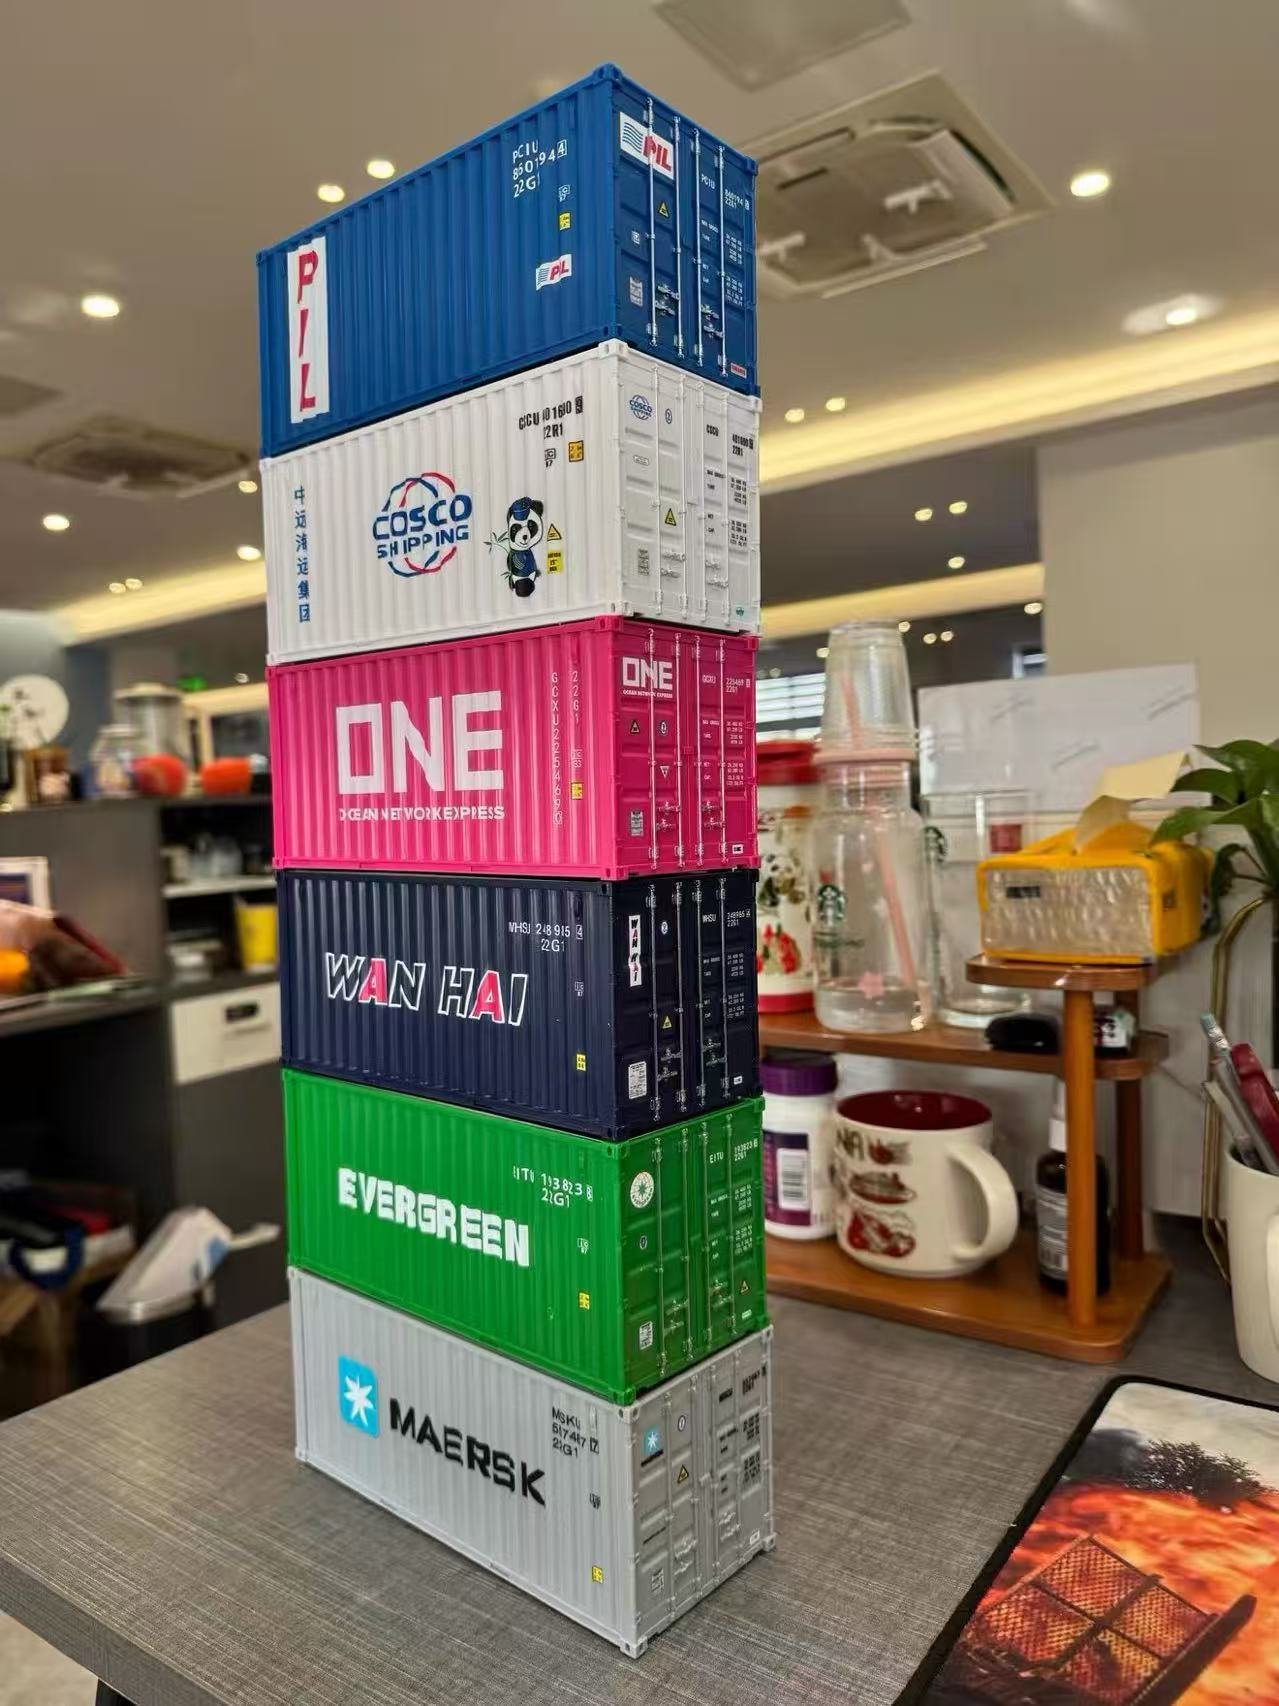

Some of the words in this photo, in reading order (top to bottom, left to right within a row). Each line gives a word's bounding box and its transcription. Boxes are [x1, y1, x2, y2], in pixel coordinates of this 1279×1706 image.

[512, 139, 539, 164] PCIU
[643, 135, 672, 172] PIL
[513, 173, 541, 198] 22G1
[298, 250, 319, 412] PIL
[629, 399, 653, 413] COSCO
[372, 494, 472, 541] COSCO
[377, 524, 469, 559] SHIPPING
[622, 656, 673, 691] ONE
[336, 690, 504, 795] ONE
[541, 938, 565, 952] 22G1
[630, 918, 639, 948] WAN
[325, 951, 427, 1012] WAN
[437, 964, 529, 1027] HAI
[709, 1151, 724, 1164] EITU
[338, 1167, 530, 1268] EVERGREEN
[389, 1397, 546, 1507] MAERSK
